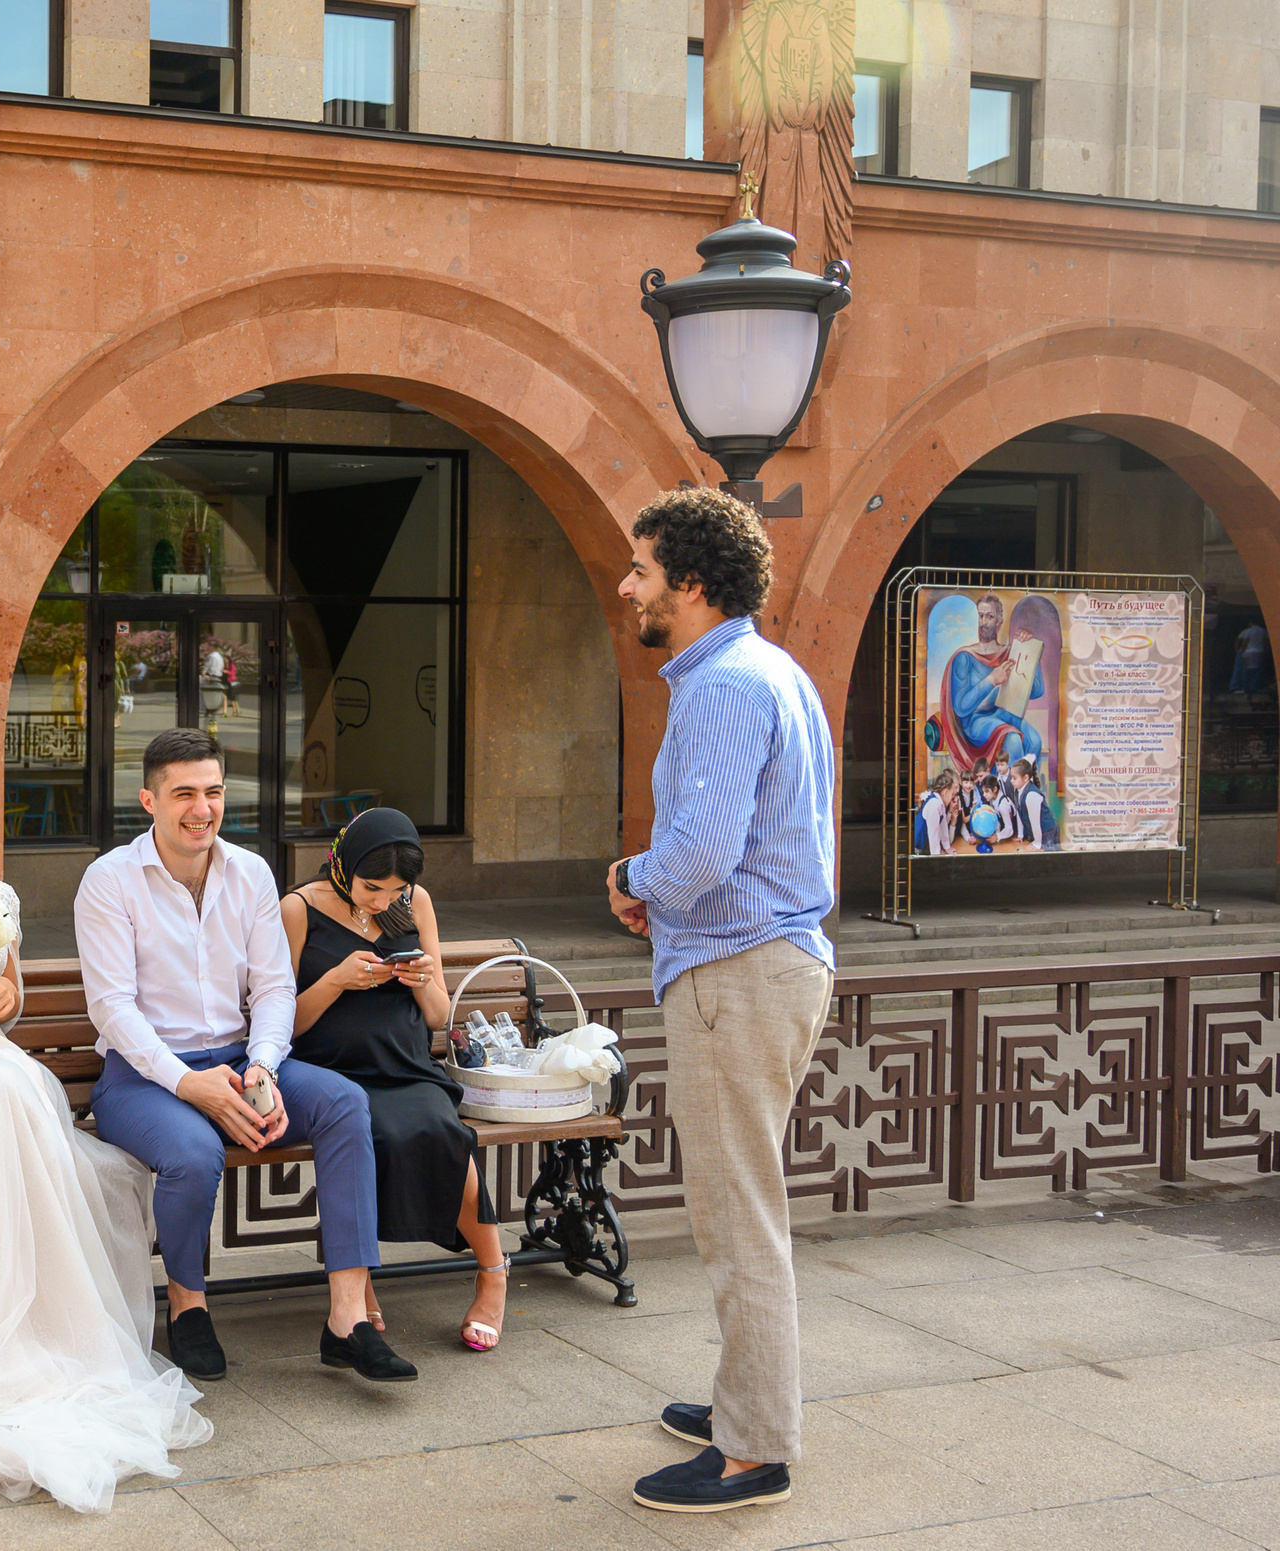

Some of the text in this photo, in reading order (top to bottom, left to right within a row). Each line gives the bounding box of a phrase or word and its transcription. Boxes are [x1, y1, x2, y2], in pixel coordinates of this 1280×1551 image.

[1090, 599, 1115, 611] Путь
[1124, 600, 1165, 612] будущее
[1090, 766, 1127, 774] АРМЕНИЕЙ
